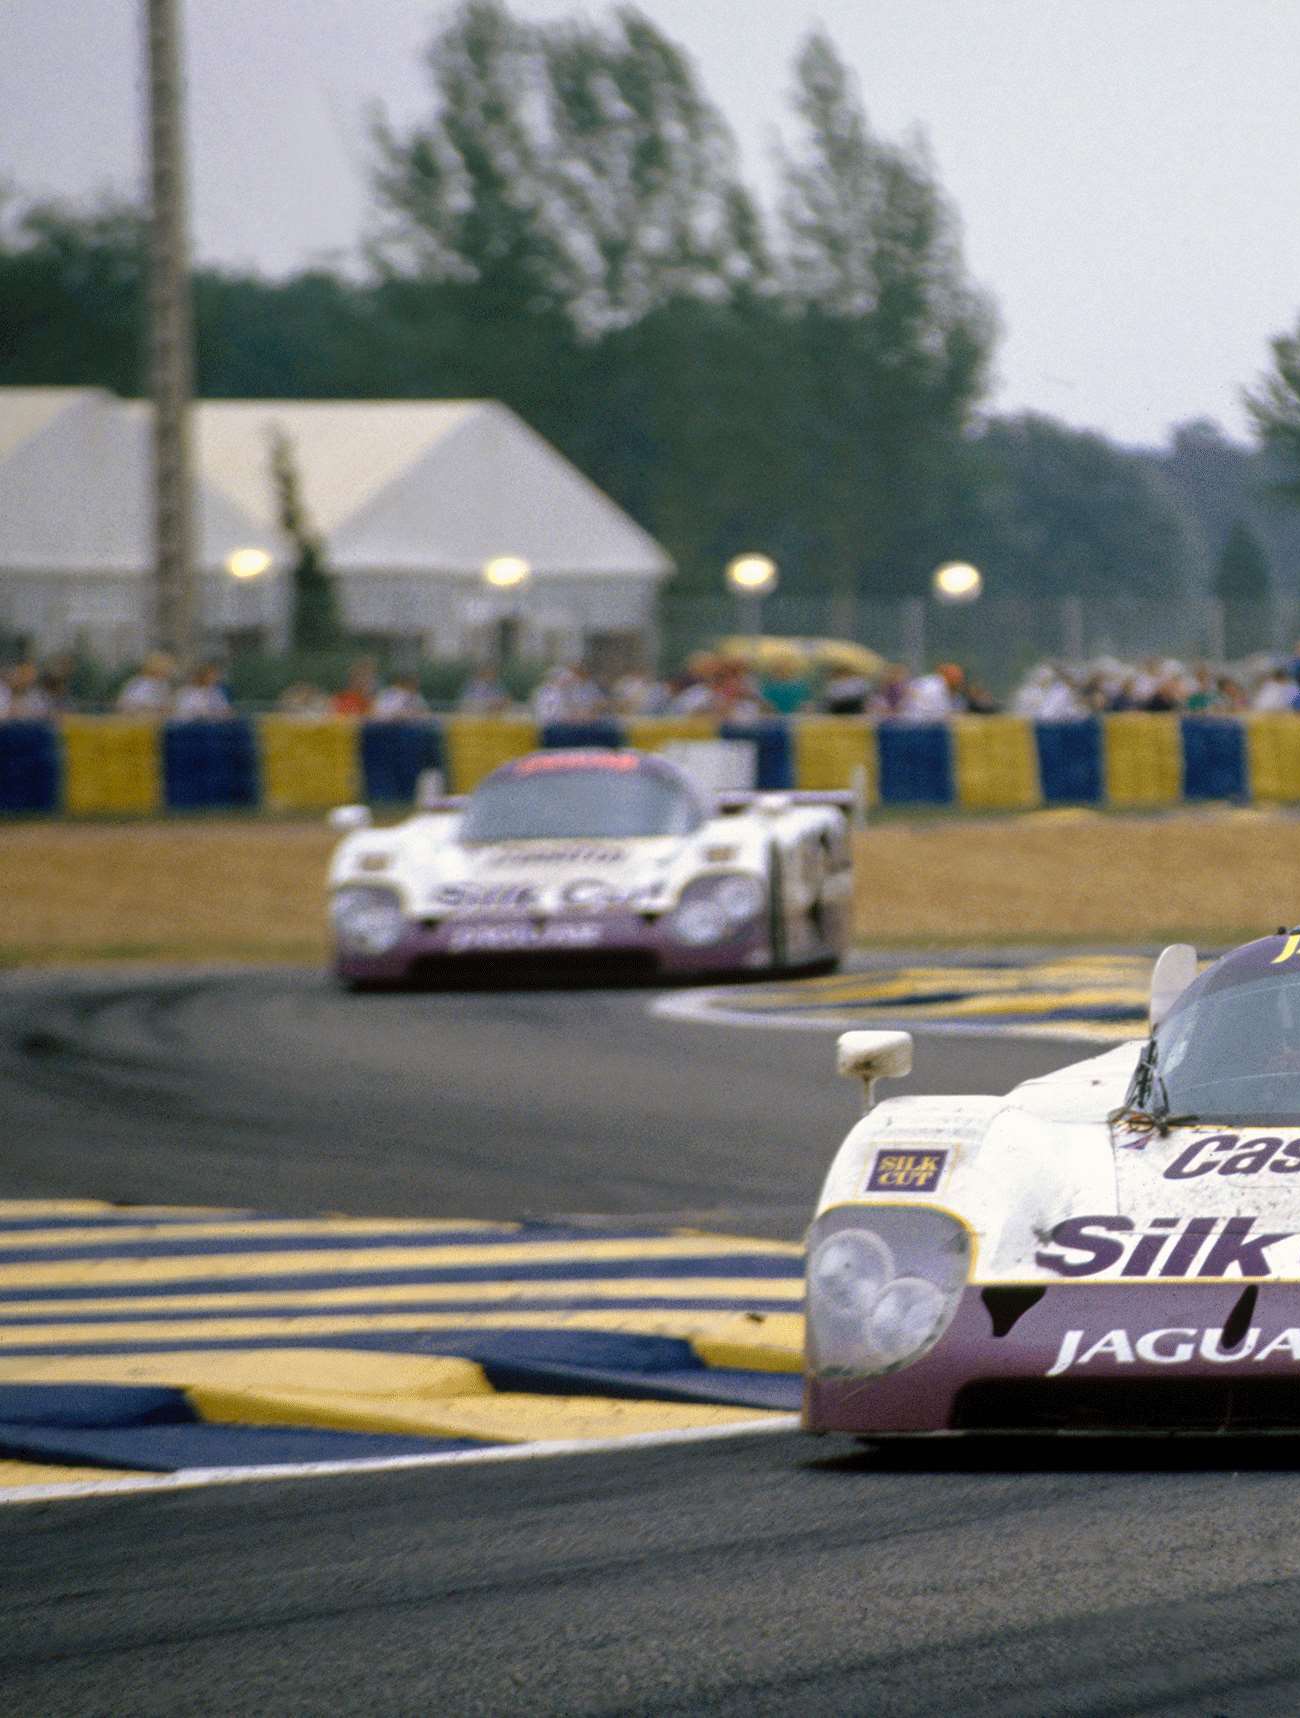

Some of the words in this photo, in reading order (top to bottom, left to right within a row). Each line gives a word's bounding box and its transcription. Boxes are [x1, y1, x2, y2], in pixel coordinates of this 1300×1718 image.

[879, 1155, 940, 1171] SILK
[878, 1171, 934, 1186] CUT
[1036, 1215, 1288, 1278] Silk
